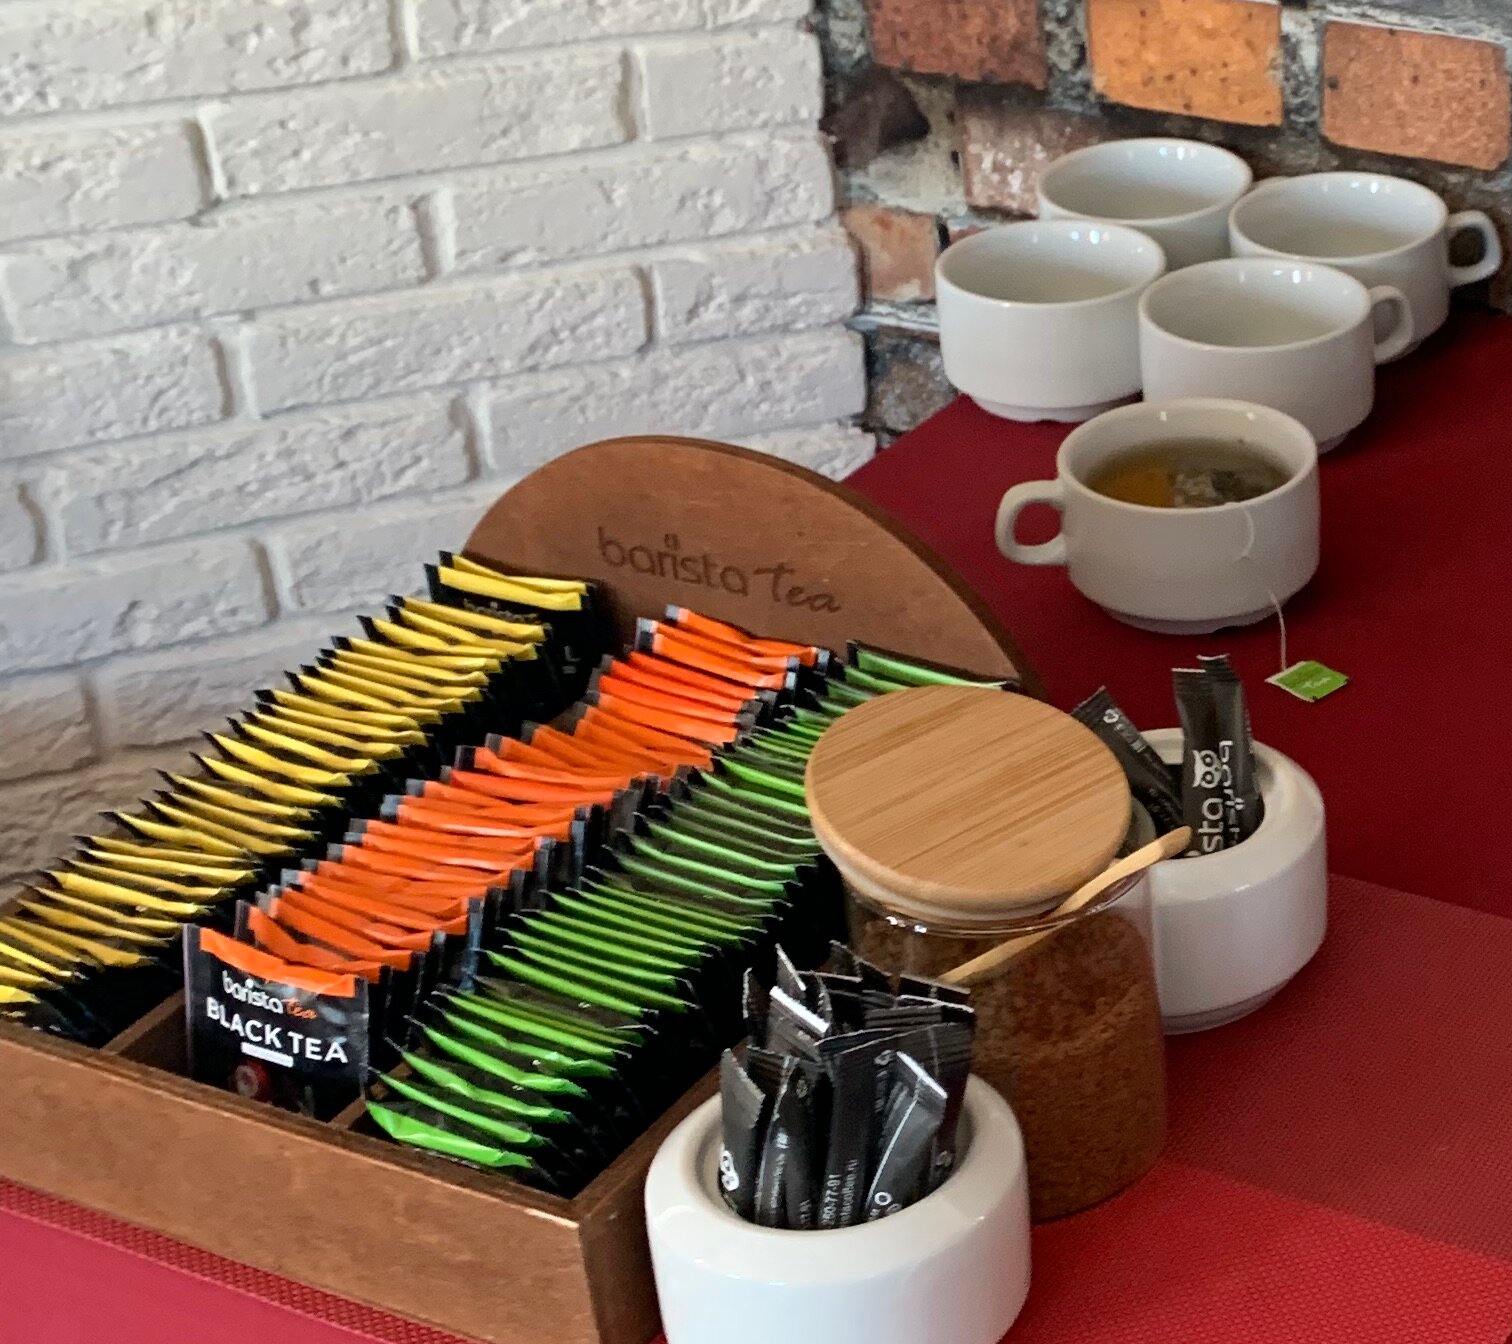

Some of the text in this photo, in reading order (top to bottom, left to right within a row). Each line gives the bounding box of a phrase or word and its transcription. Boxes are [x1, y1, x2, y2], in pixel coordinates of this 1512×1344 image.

[598, 526, 749, 596] barista
[222, 970, 284, 1014] barista
[206, 996, 349, 1064] BLACK TEA
